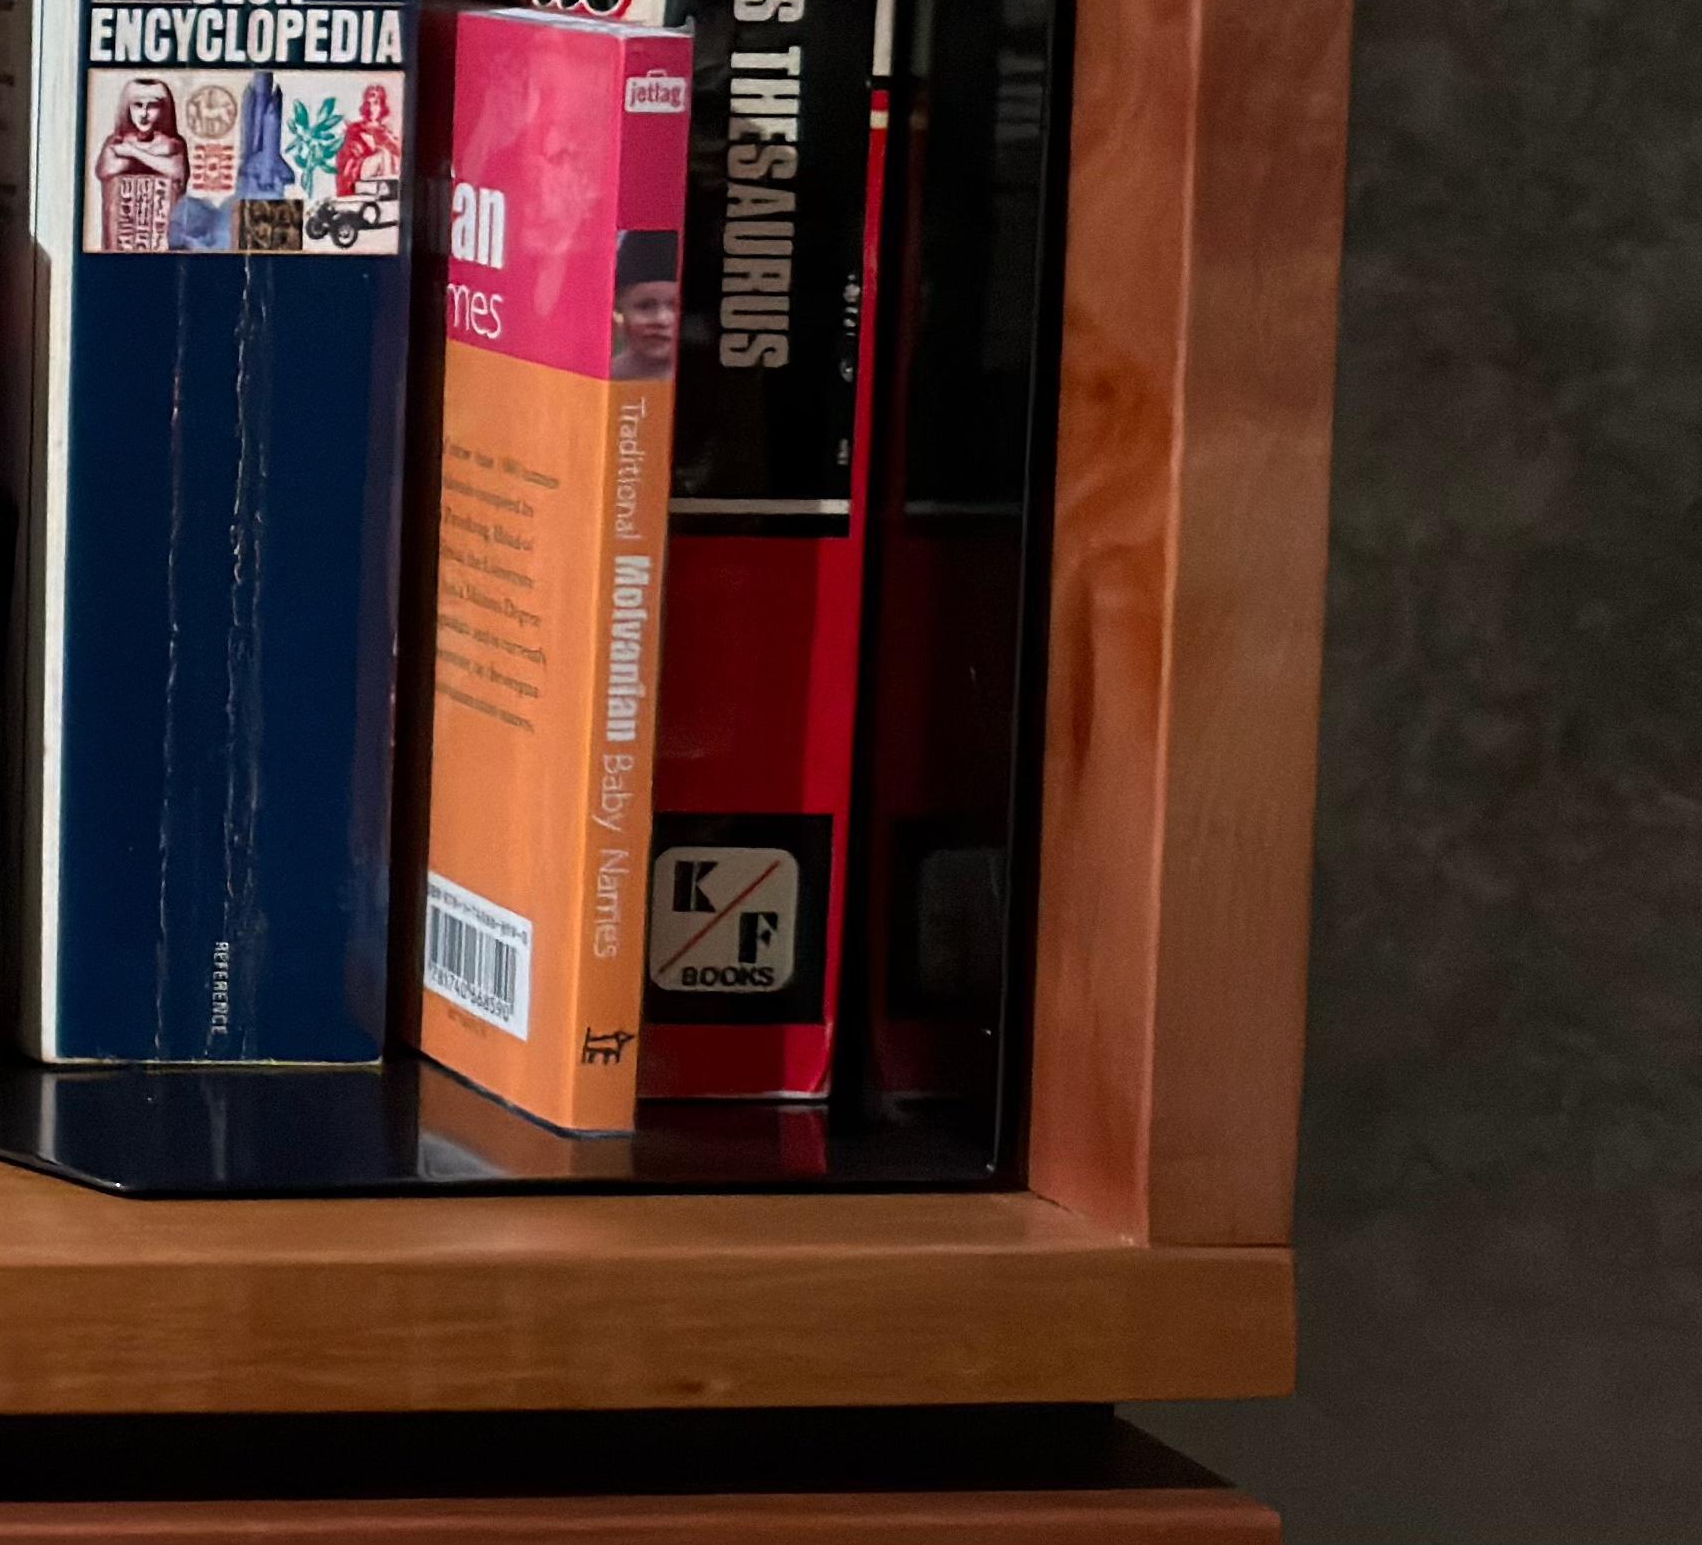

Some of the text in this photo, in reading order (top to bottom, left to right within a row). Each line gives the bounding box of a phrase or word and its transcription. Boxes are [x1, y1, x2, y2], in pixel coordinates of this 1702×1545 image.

[90, 8, 404, 63] ENCYCLOPEDIA
[629, 78, 681, 108] jetlag
[719, 46, 801, 368] THESAURUS
[591, 397, 651, 959] Traditional Molvanian Baby Names
[211, 941, 229, 1035] REFERENCE
[682, 967, 774, 986] BOOKS
